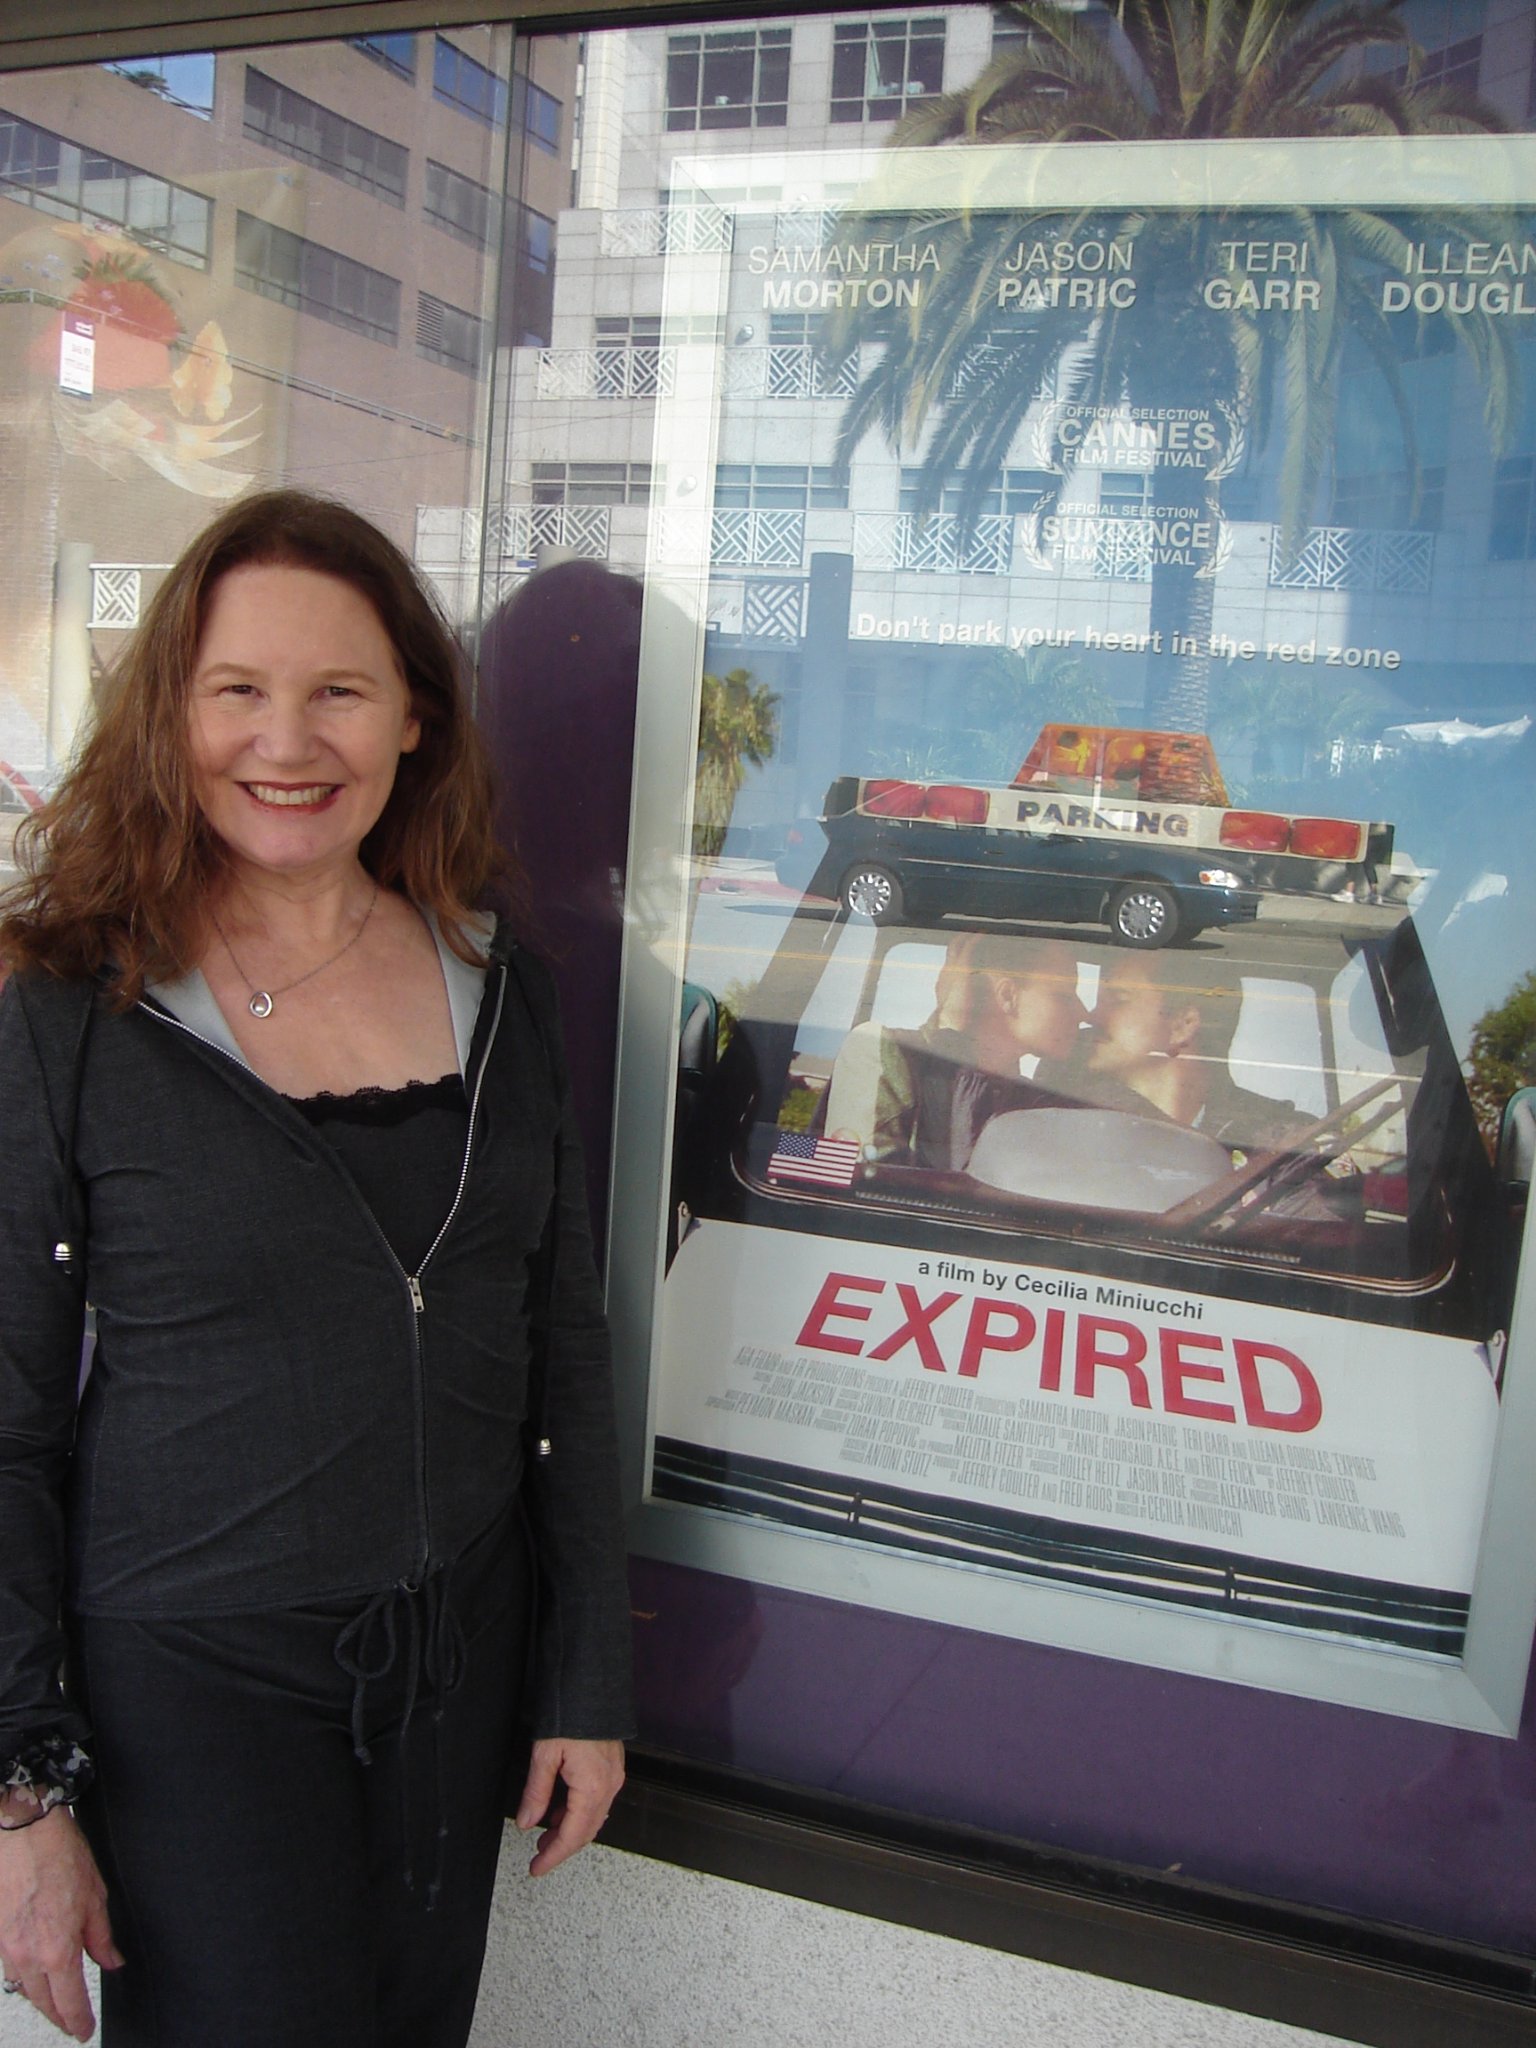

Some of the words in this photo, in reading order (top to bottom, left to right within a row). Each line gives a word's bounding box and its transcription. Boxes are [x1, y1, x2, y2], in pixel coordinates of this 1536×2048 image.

[748, 244, 940, 274] SAMANTHA
[1005, 241, 1132, 272] JASON
[1222, 242, 1308, 273] TERI
[762, 279, 921, 308] MORTON
[998, 278, 1137, 309] PATRIC
[1203, 279, 1321, 312] GARR
[1066, 406, 1126, 420] OFFICIAL
[1132, 408, 1209, 421] SELECTION
[1058, 419, 1216, 450] CANNES
[1063, 448, 1108, 464] FILM
[1114, 450, 1206, 468] FESTIVAL
[1057, 502, 1117, 516] OFFICIAL
[1122, 506, 1199, 519] SELECTION
[1053, 544, 1097, 560] FILM
[857, 614, 929, 638] Don't
[938, 620, 1002, 644] park
[1011, 626, 1076, 650] your
[1084, 626, 1162, 654] heart
[1172, 630, 1198, 656] in
[1208, 634, 1256, 660] the
[1266, 640, 1316, 664] red
[1325, 646, 1401, 669] zone
[918, 1262, 930, 1276] a
[936, 1262, 976, 1284] film
[982, 1269, 1007, 1292] by
[1015, 1274, 1088, 1302] Cecilia
[1096, 1286, 1204, 1320] Miniucchi
[794, 1272, 1322, 1434] EXPIRED
[804, 1360, 866, 1388] PRODUCTIONS
[901, 1378, 936, 1404] JEFFREY
[936, 1384, 974, 1410] COULTER
[1018, 1398, 1068, 1426] SAMANTHA
[1071, 1407, 1108, 1434] MORTON
[1115, 1416, 1145, 1441] JASON
[1146, 1422, 1177, 1447] PATRIC
[1182, 1427, 1202, 1450] TERI
[1204, 1432, 1229, 1456] GARR
[1286, 1444, 1332, 1474] DOUGLAS
[767, 1376, 796, 1399] JOHN
[793, 1381, 838, 1406] JACKSON
[966, 1413, 1001, 1439] NATALIE
[1003, 1418, 1056, 1448] SANFILIPPO
[1075, 1432, 1099, 1458] ANNE
[1200, 1454, 1226, 1481] FRITZ
[1276, 1467, 1314, 1496] JEFFREY
[1314, 1474, 1359, 1504] COULTER
[846, 1413, 880, 1440] ZORAN
[879, 1420, 920, 1448] POPOVIC
[1060, 1454, 1092, 1482] HOLLEY
[1094, 1461, 1120, 1488] HEITZ
[1126, 1466, 1159, 1492] JASON
[1162, 1472, 1186, 1499] ROSE
[1219, 1483, 1276, 1516] ALEXANDER
[1314, 1499, 1372, 1532] LAWRENCE
[1369, 1508, 1406, 1538] WANG
[864, 1443, 899, 1471] ANTONI
[902, 1450, 932, 1478] STUTZ
[958, 1460, 998, 1489] JEFFREY
[1000, 1468, 1040, 1498] COULTER
[1042, 1482, 1057, 1502] AND
[1059, 1479, 1082, 1507] FRED
[1086, 1484, 1112, 1512] ROOS
[1148, 1498, 1184, 1526] CECILIA
[1187, 1502, 1243, 1538] MINIUCCHI
